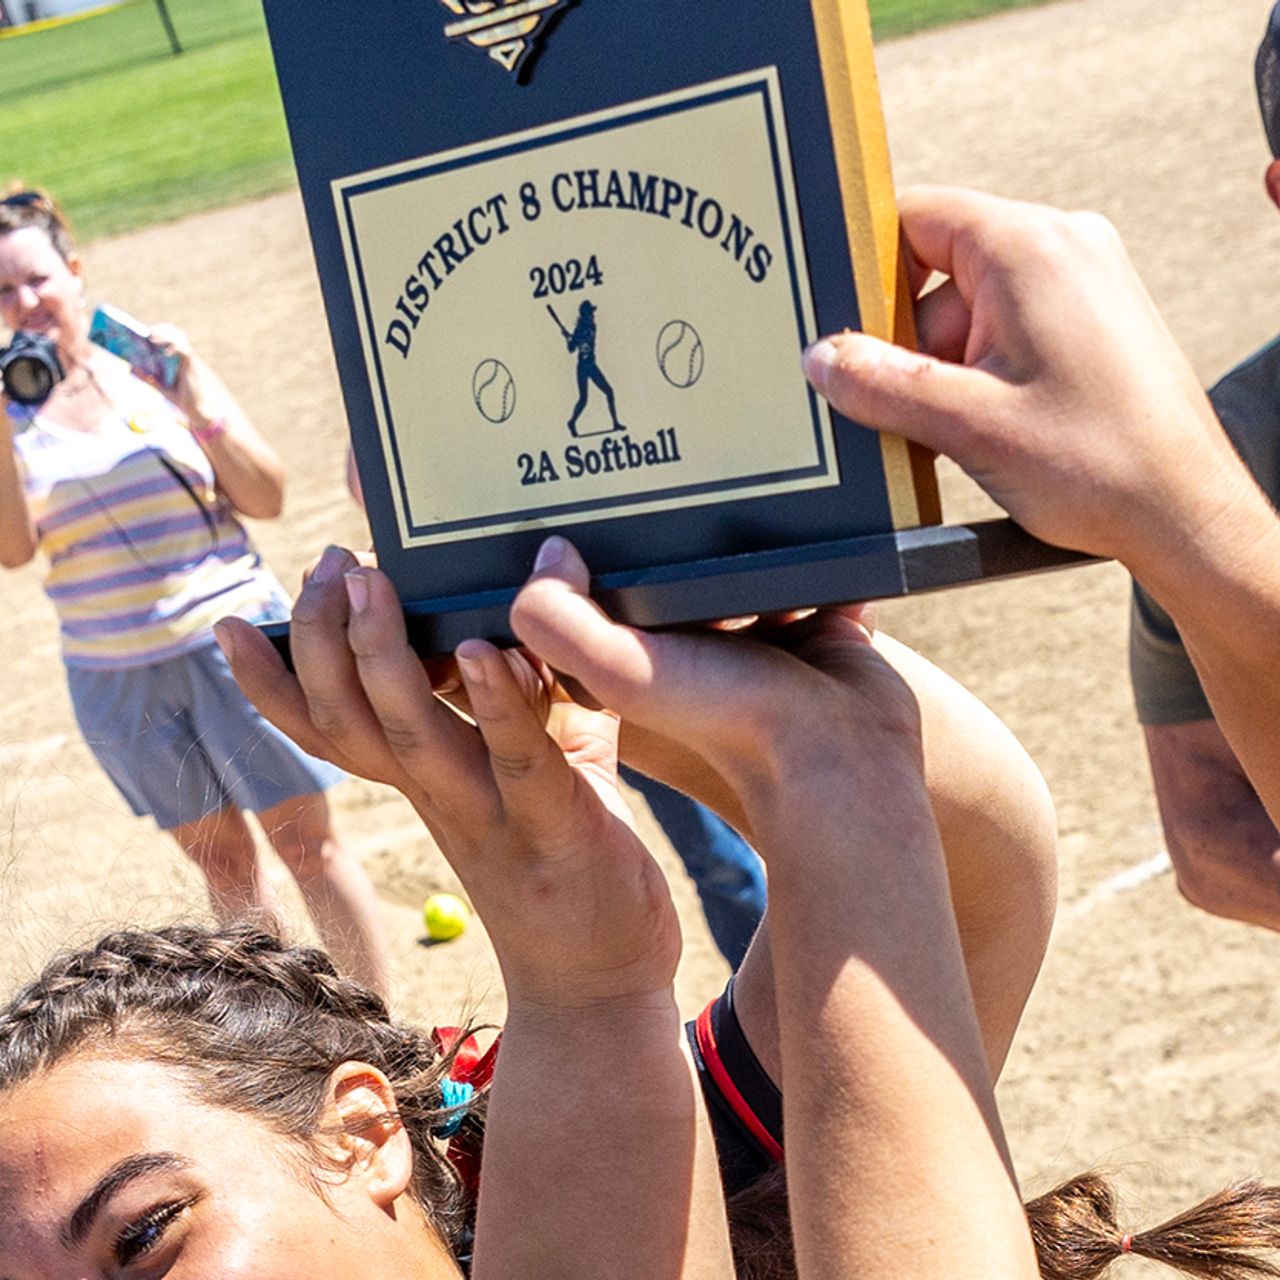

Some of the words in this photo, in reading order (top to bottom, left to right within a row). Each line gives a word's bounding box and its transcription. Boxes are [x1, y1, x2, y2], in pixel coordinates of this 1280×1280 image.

[385, 193, 510, 360] DISTRICT
[519, 181, 542, 222] 8
[551, 168, 774, 284] CHAMPIONS
[529, 254, 604, 299] 2024
[517, 450, 560, 486] 2A
[564, 427, 682, 479] Softball
